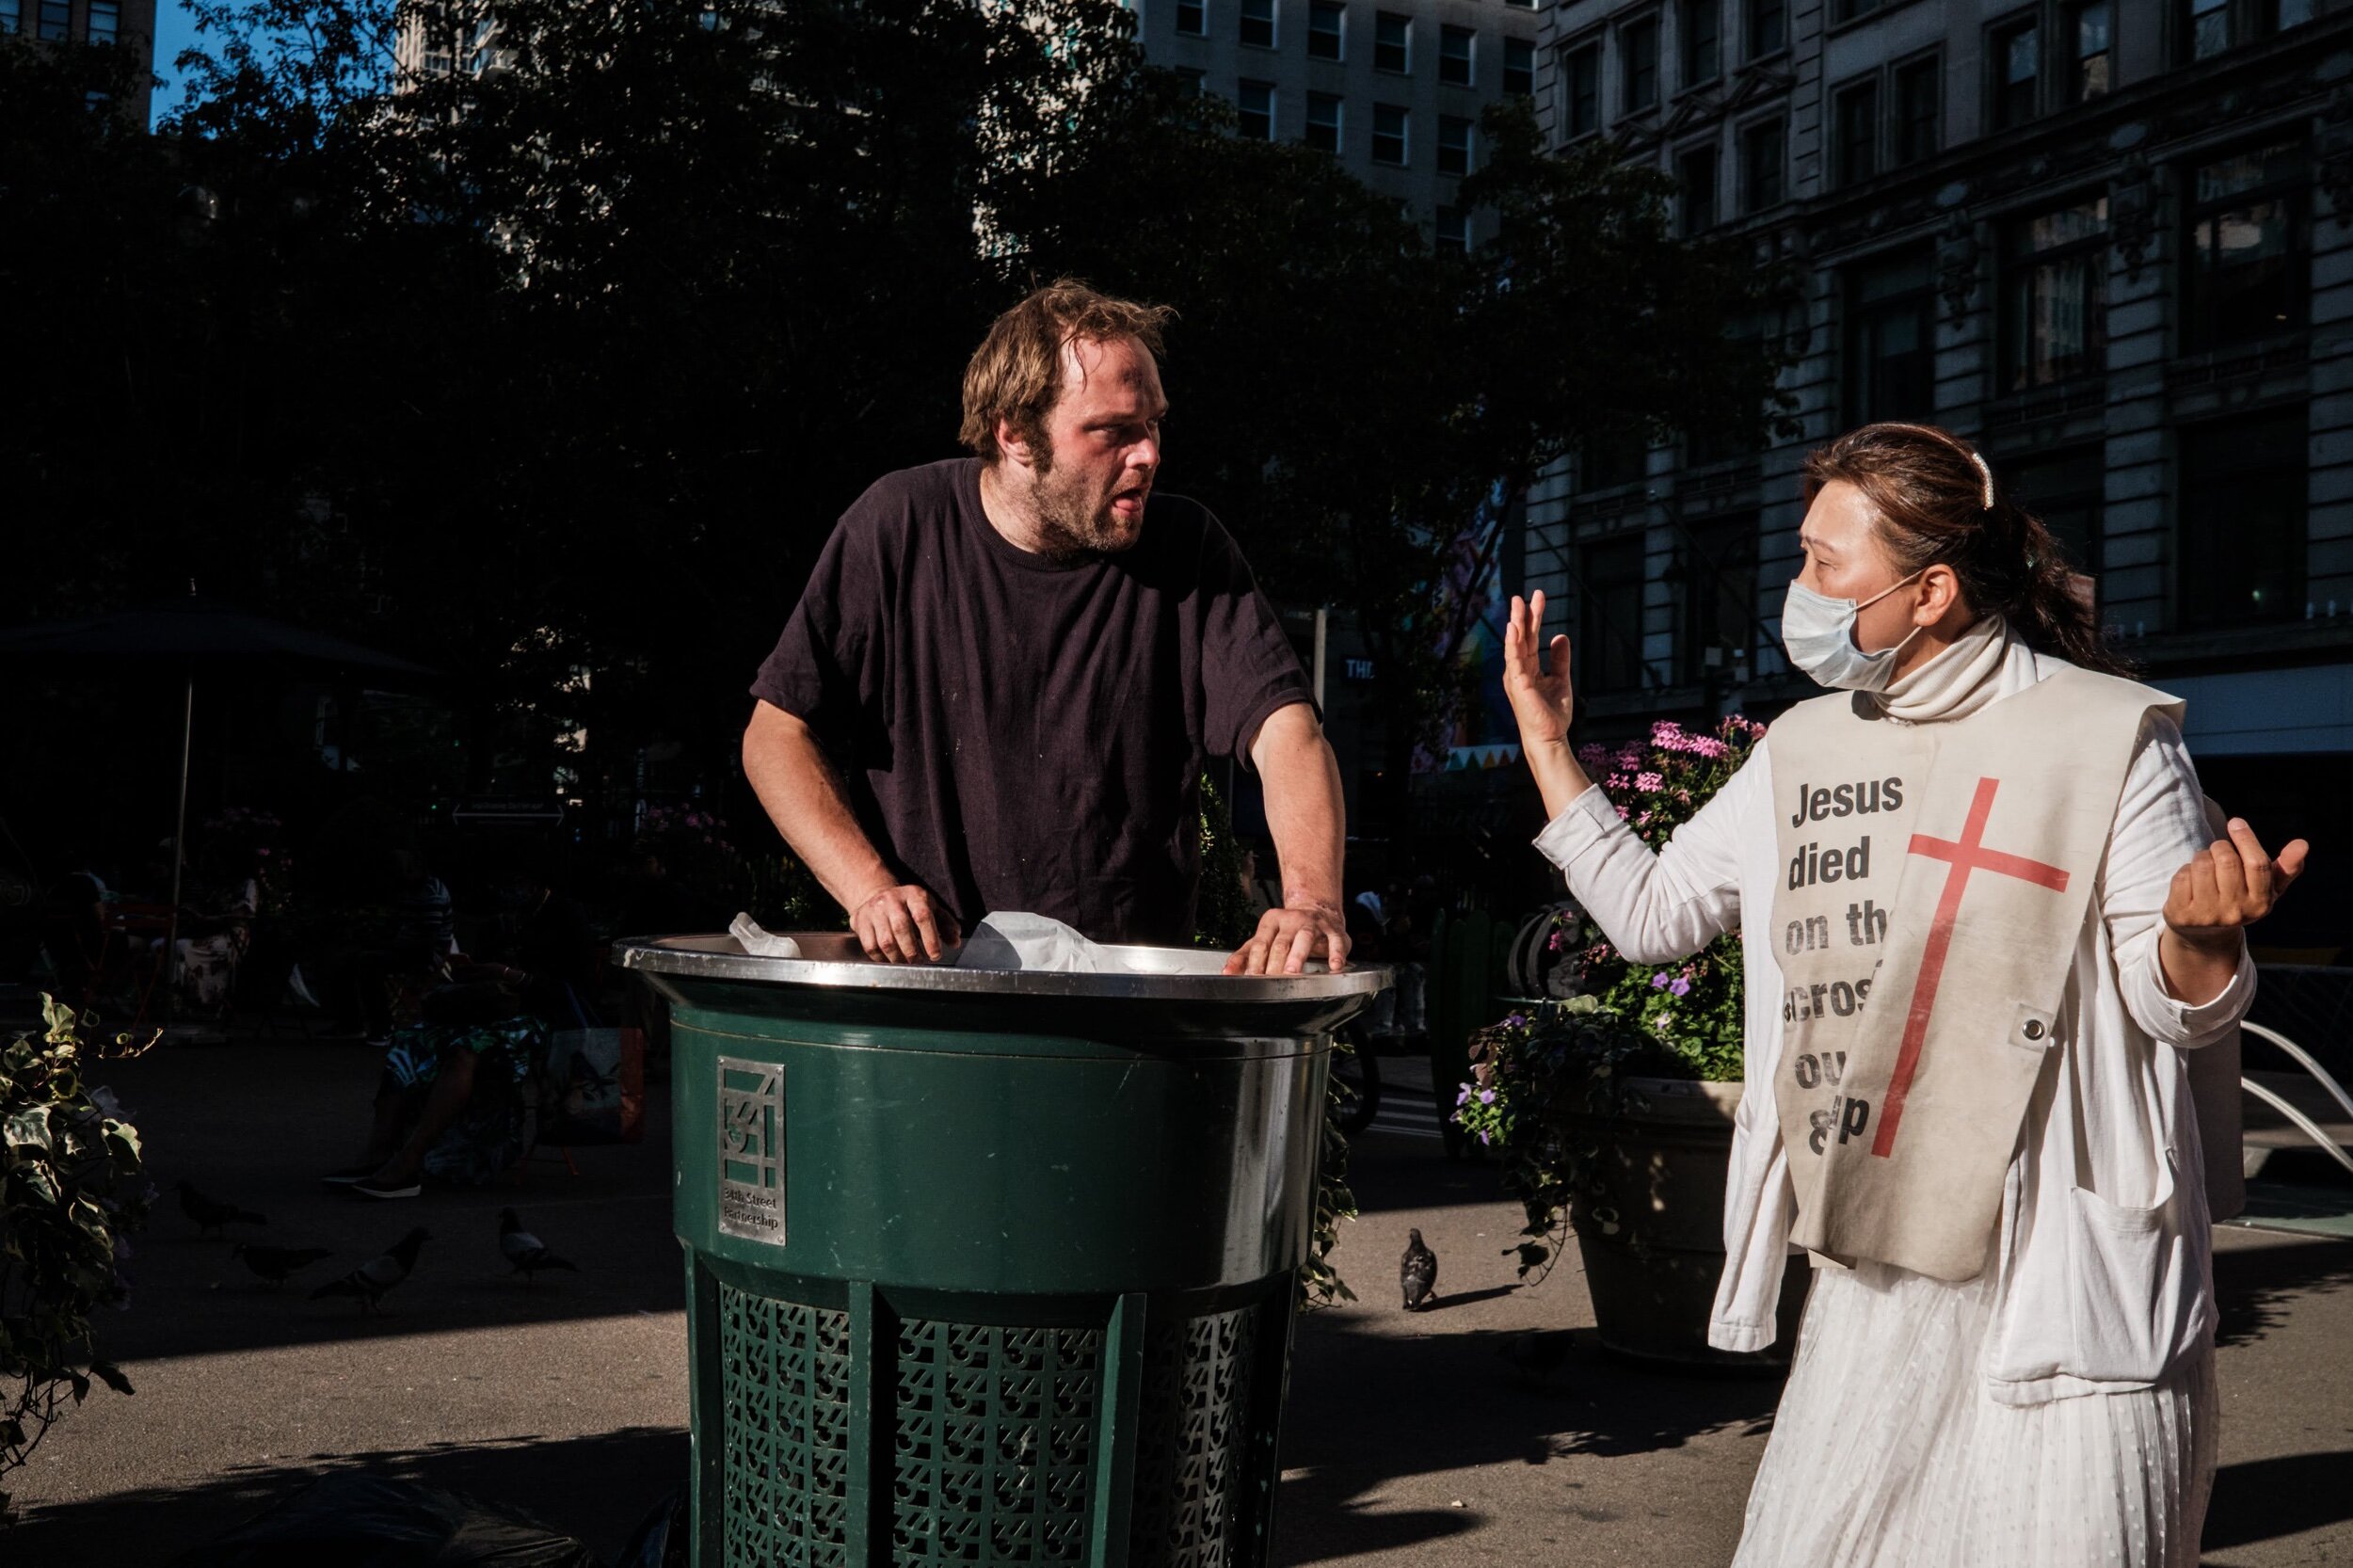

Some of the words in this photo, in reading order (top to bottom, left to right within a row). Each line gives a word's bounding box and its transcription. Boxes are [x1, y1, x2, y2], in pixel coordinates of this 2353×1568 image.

[1792, 776, 1903, 828] Jesus
[1788, 836, 1870, 891] died
[1785, 915, 1829, 955] on
[1846, 900, 1894, 947] th
[724, 1206, 778, 1230] Partnership
[746, 1192, 776, 1208] Street
